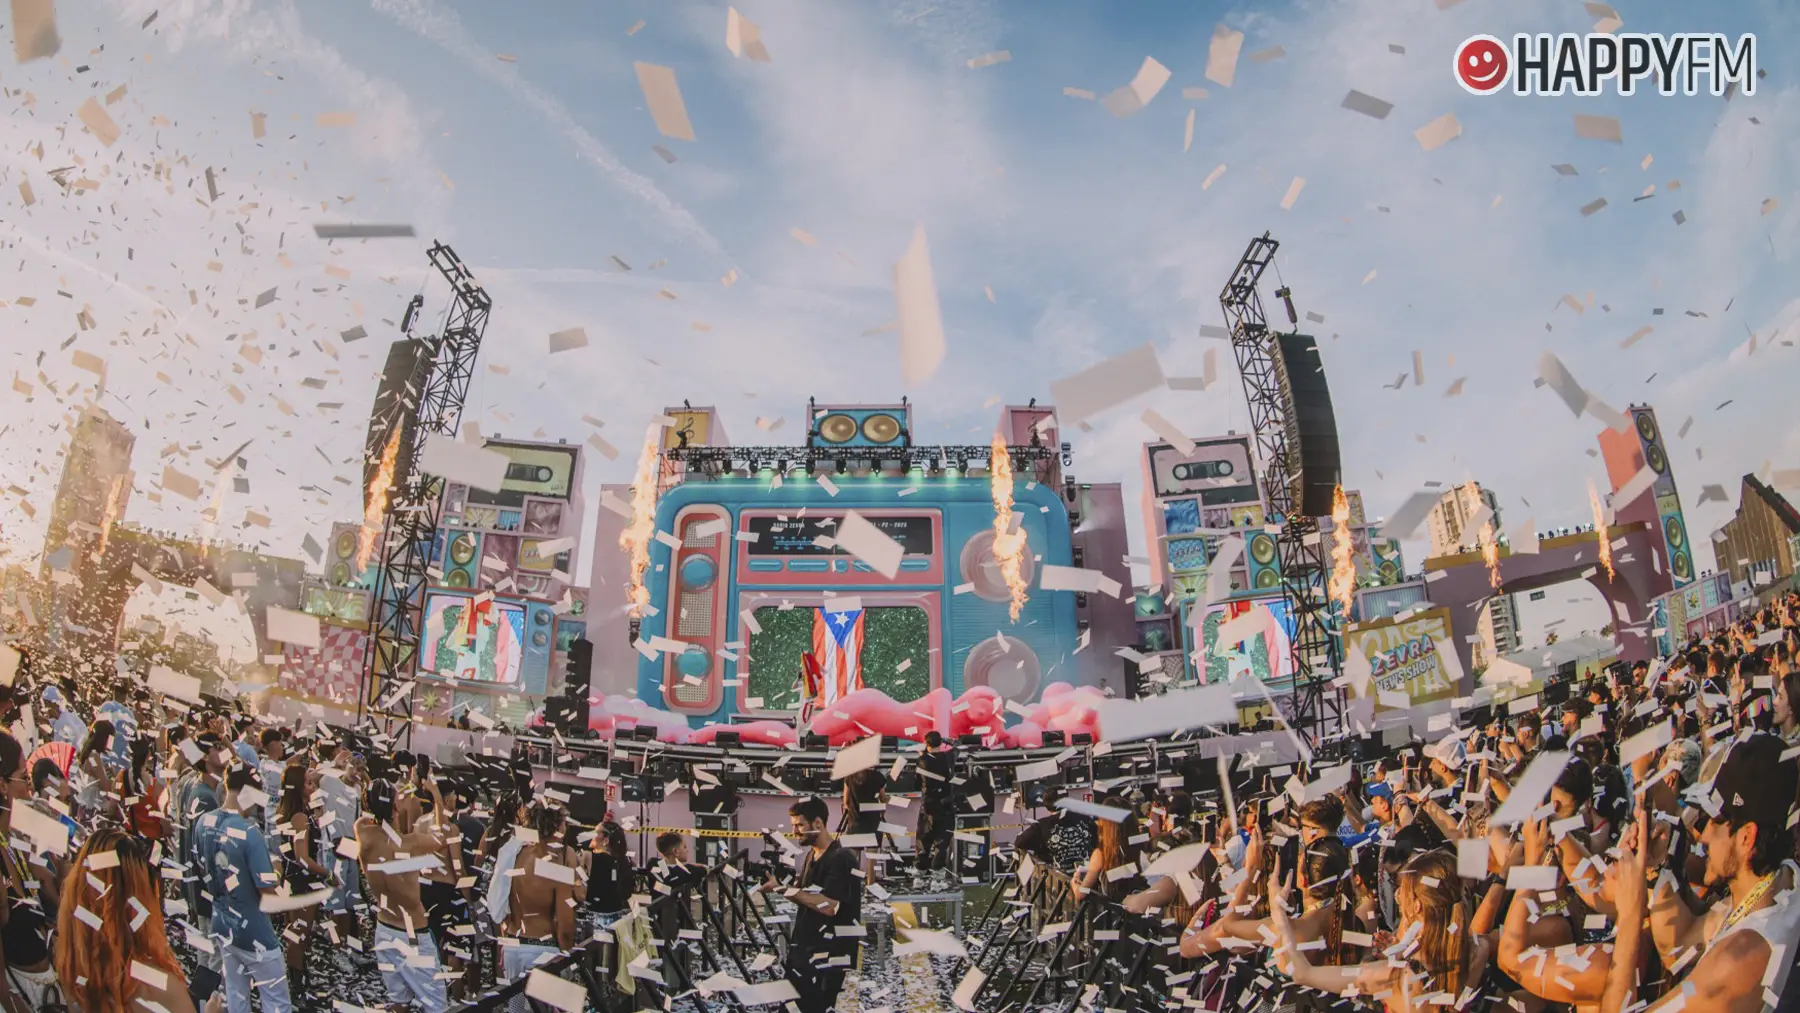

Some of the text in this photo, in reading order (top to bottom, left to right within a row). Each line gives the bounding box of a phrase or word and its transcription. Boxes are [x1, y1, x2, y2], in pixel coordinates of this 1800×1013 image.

[1370, 634, 1435, 677] ZEVRA
[1376, 653, 1436, 693] NEWS SHOW
